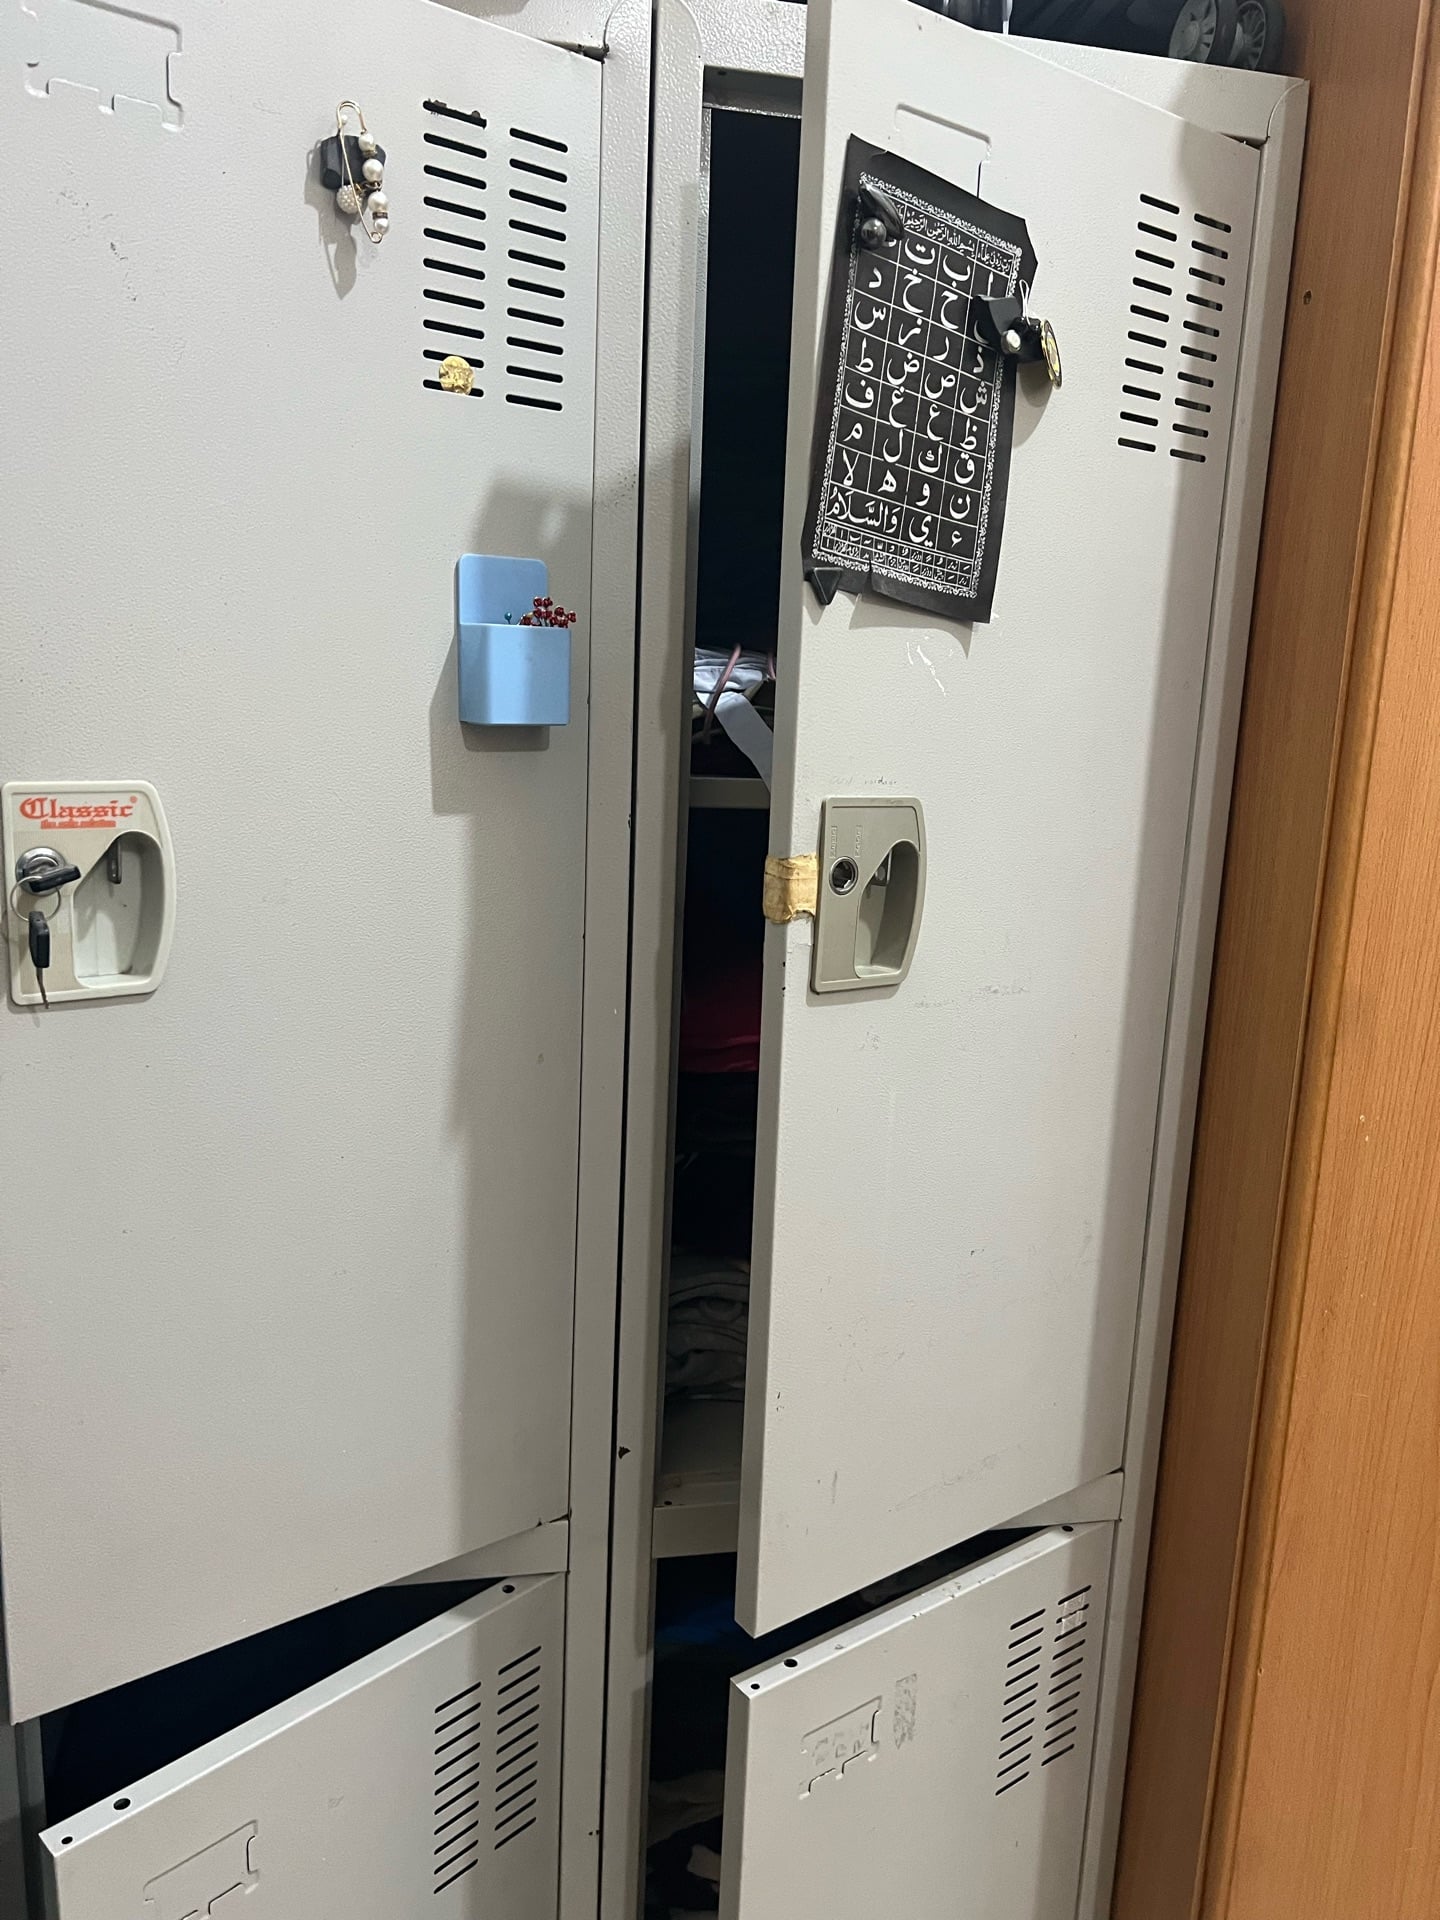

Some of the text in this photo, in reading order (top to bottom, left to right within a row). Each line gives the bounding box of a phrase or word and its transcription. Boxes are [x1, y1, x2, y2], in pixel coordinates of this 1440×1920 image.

[904, 238, 936, 265] ت
[868, 267, 882, 289] د
[942, 253, 972, 289] ب
[903, 268, 924, 315] خ
[854, 301, 887, 331] س
[897, 317, 922, 346] ز
[933, 336, 950, 361] ر
[854, 337, 988, 414] ش ص ض ط
[844, 379, 978, 451] ظ ع غ ف
[844, 422, 976, 485] ق ك ل م
[842, 449, 971, 520] ن و ه لا
[908, 515, 934, 548] ي
[19, 796, 134, 820] Classic
